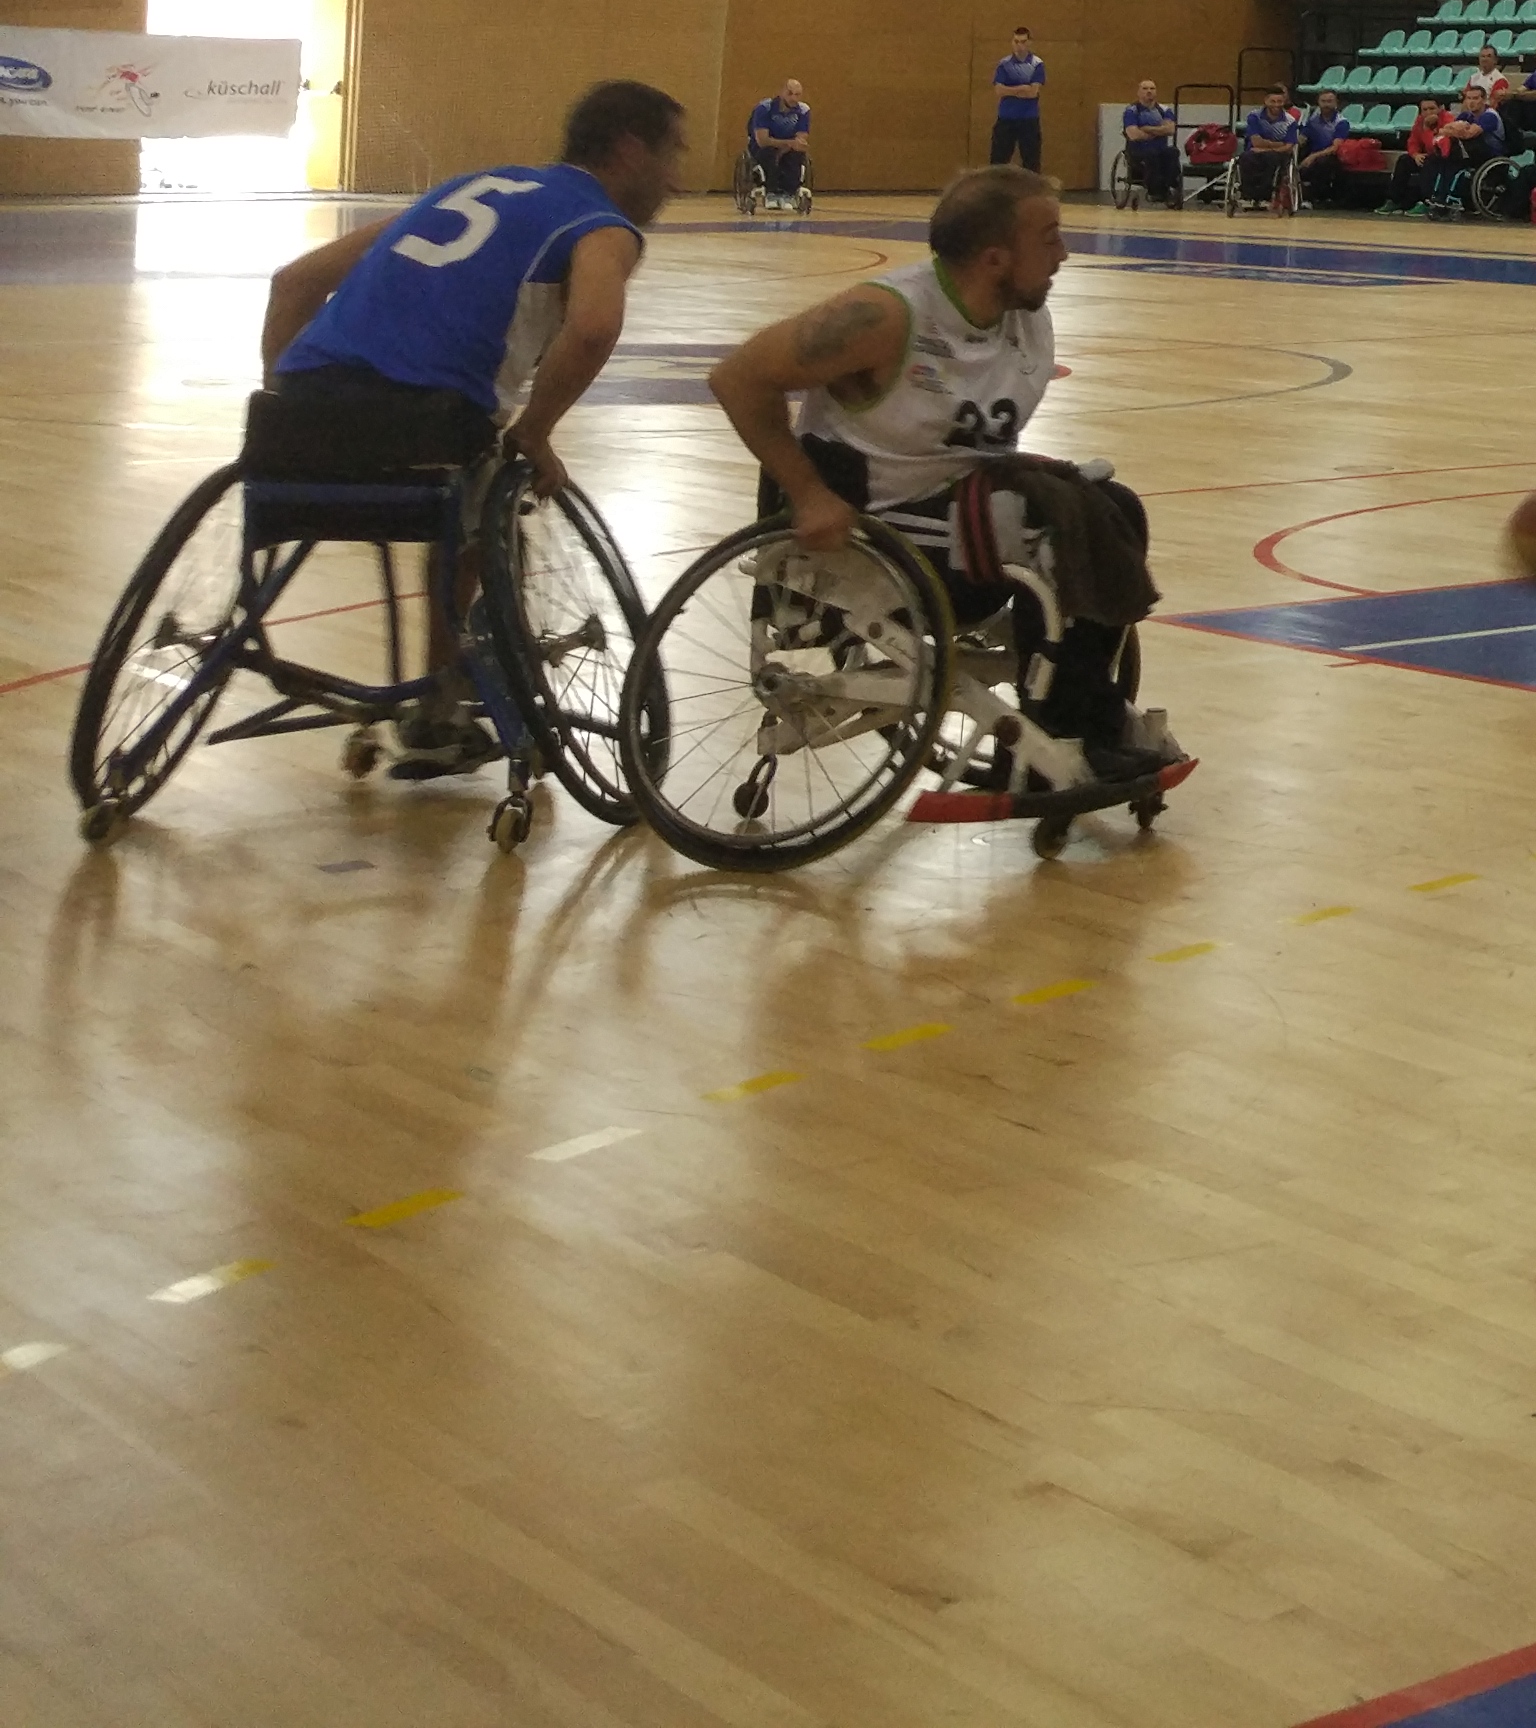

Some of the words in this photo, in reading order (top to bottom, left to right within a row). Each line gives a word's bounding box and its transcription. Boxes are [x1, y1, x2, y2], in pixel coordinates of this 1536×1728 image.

[207, 79, 282, 96] küschall
[389, 173, 546, 268] 5
[942, 397, 1018, 450] 22
